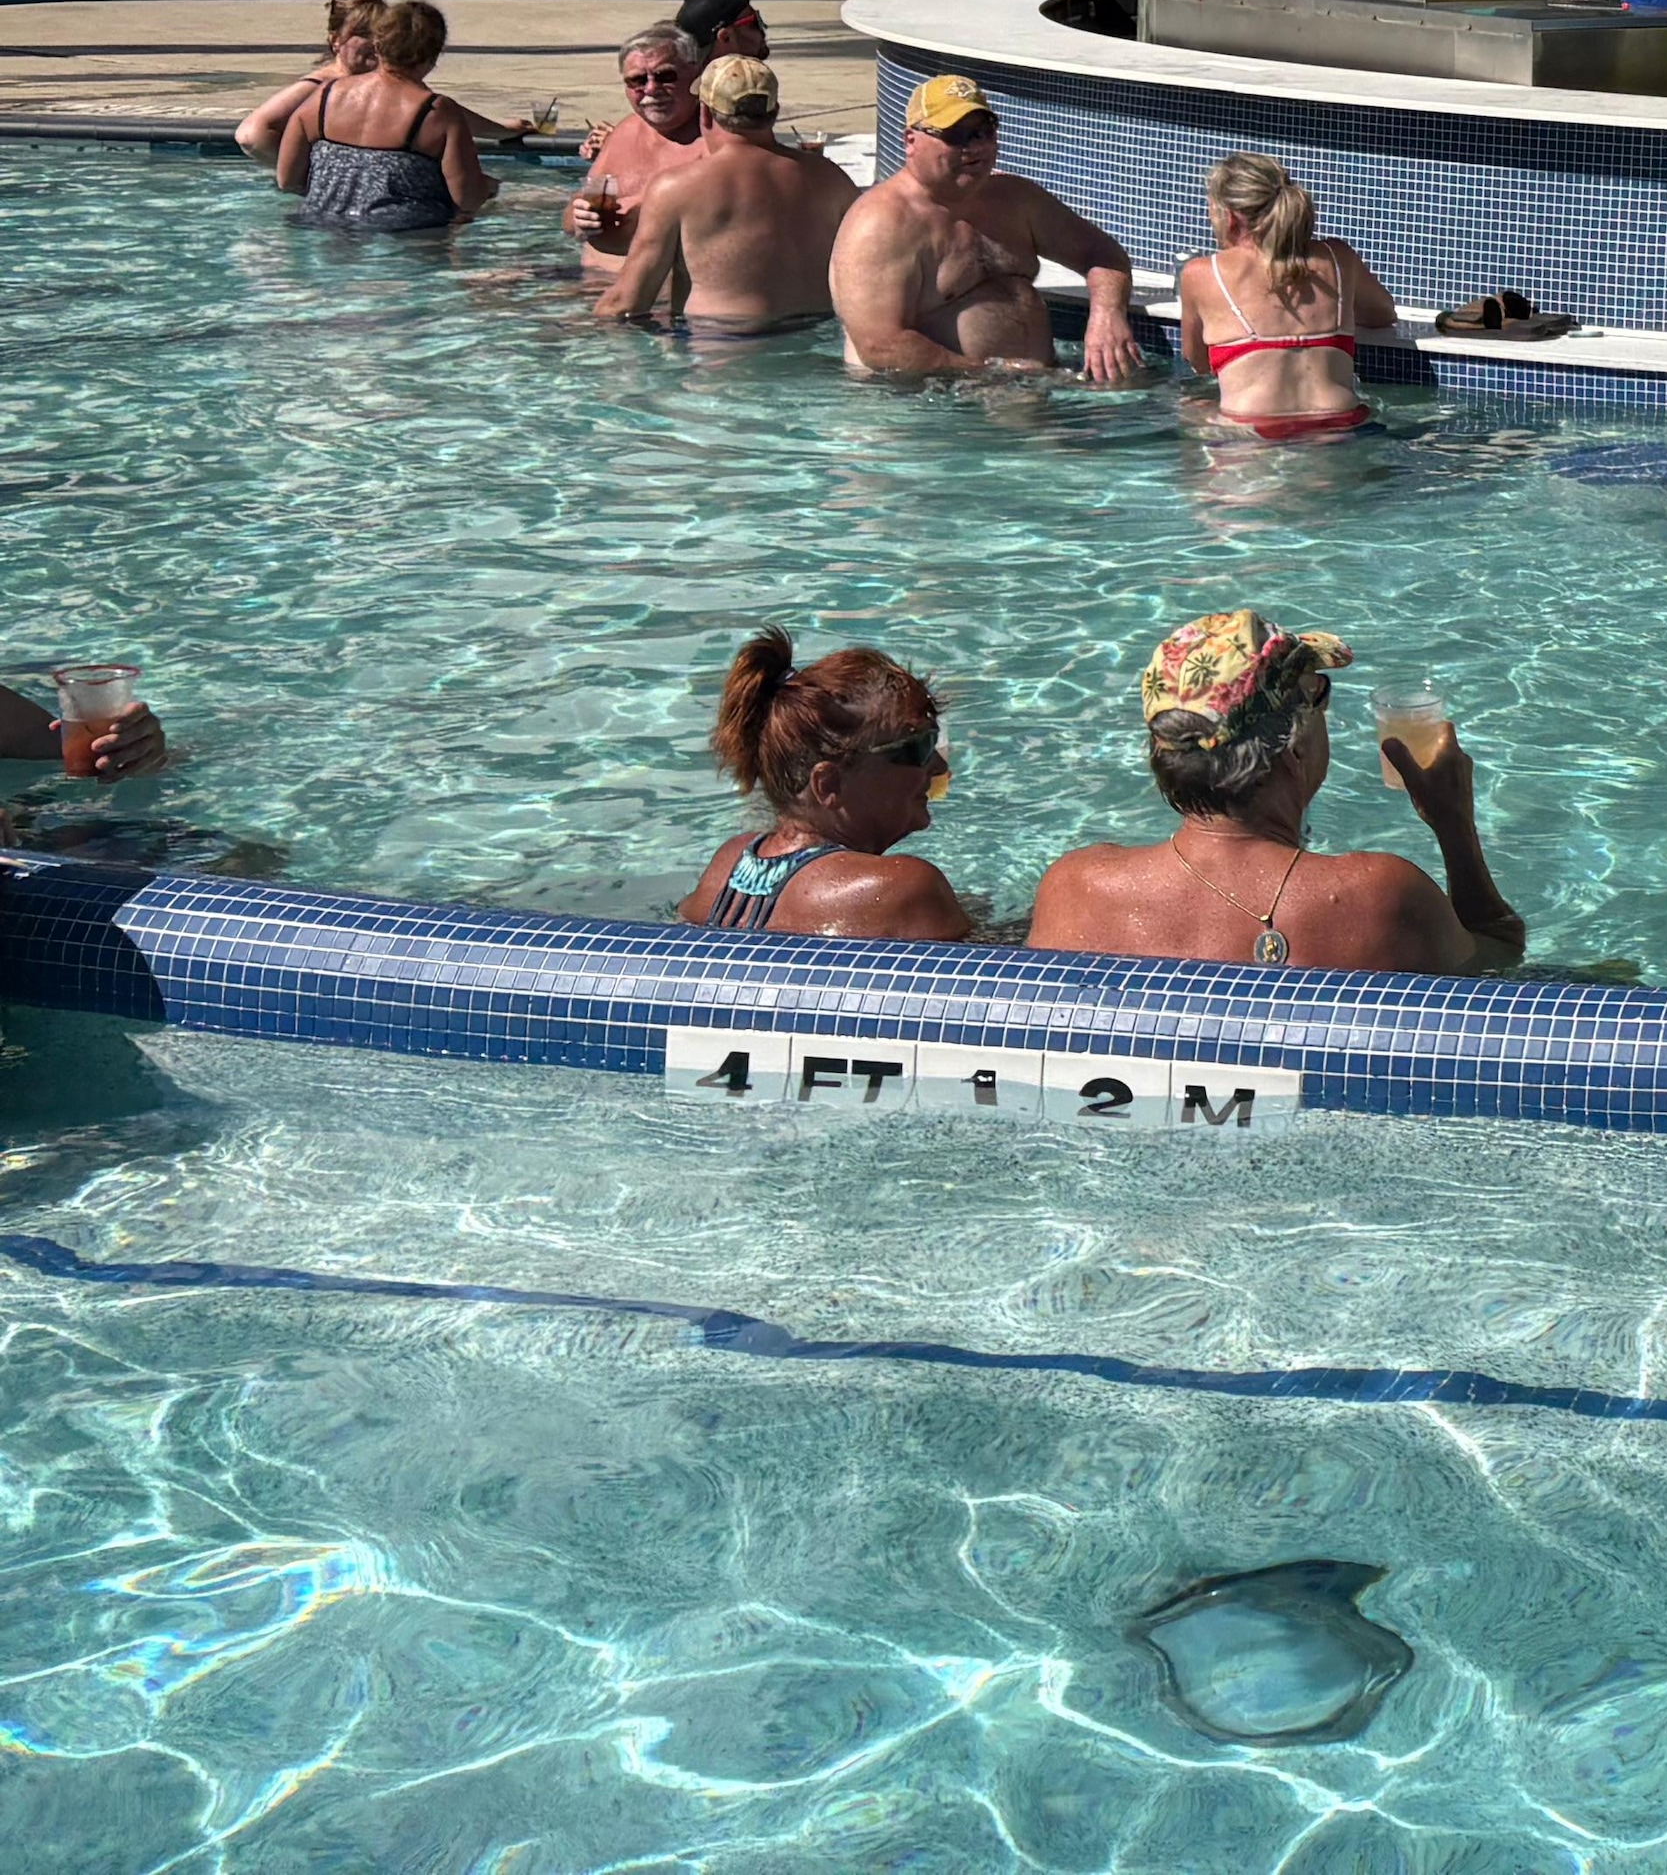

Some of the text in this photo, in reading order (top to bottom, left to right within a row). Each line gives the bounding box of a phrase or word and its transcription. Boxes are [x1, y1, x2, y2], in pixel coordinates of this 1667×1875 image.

[695, 1051, 753, 1098] 4
[799, 1055, 904, 1104] FT
[1179, 1084, 1257, 1128] M
